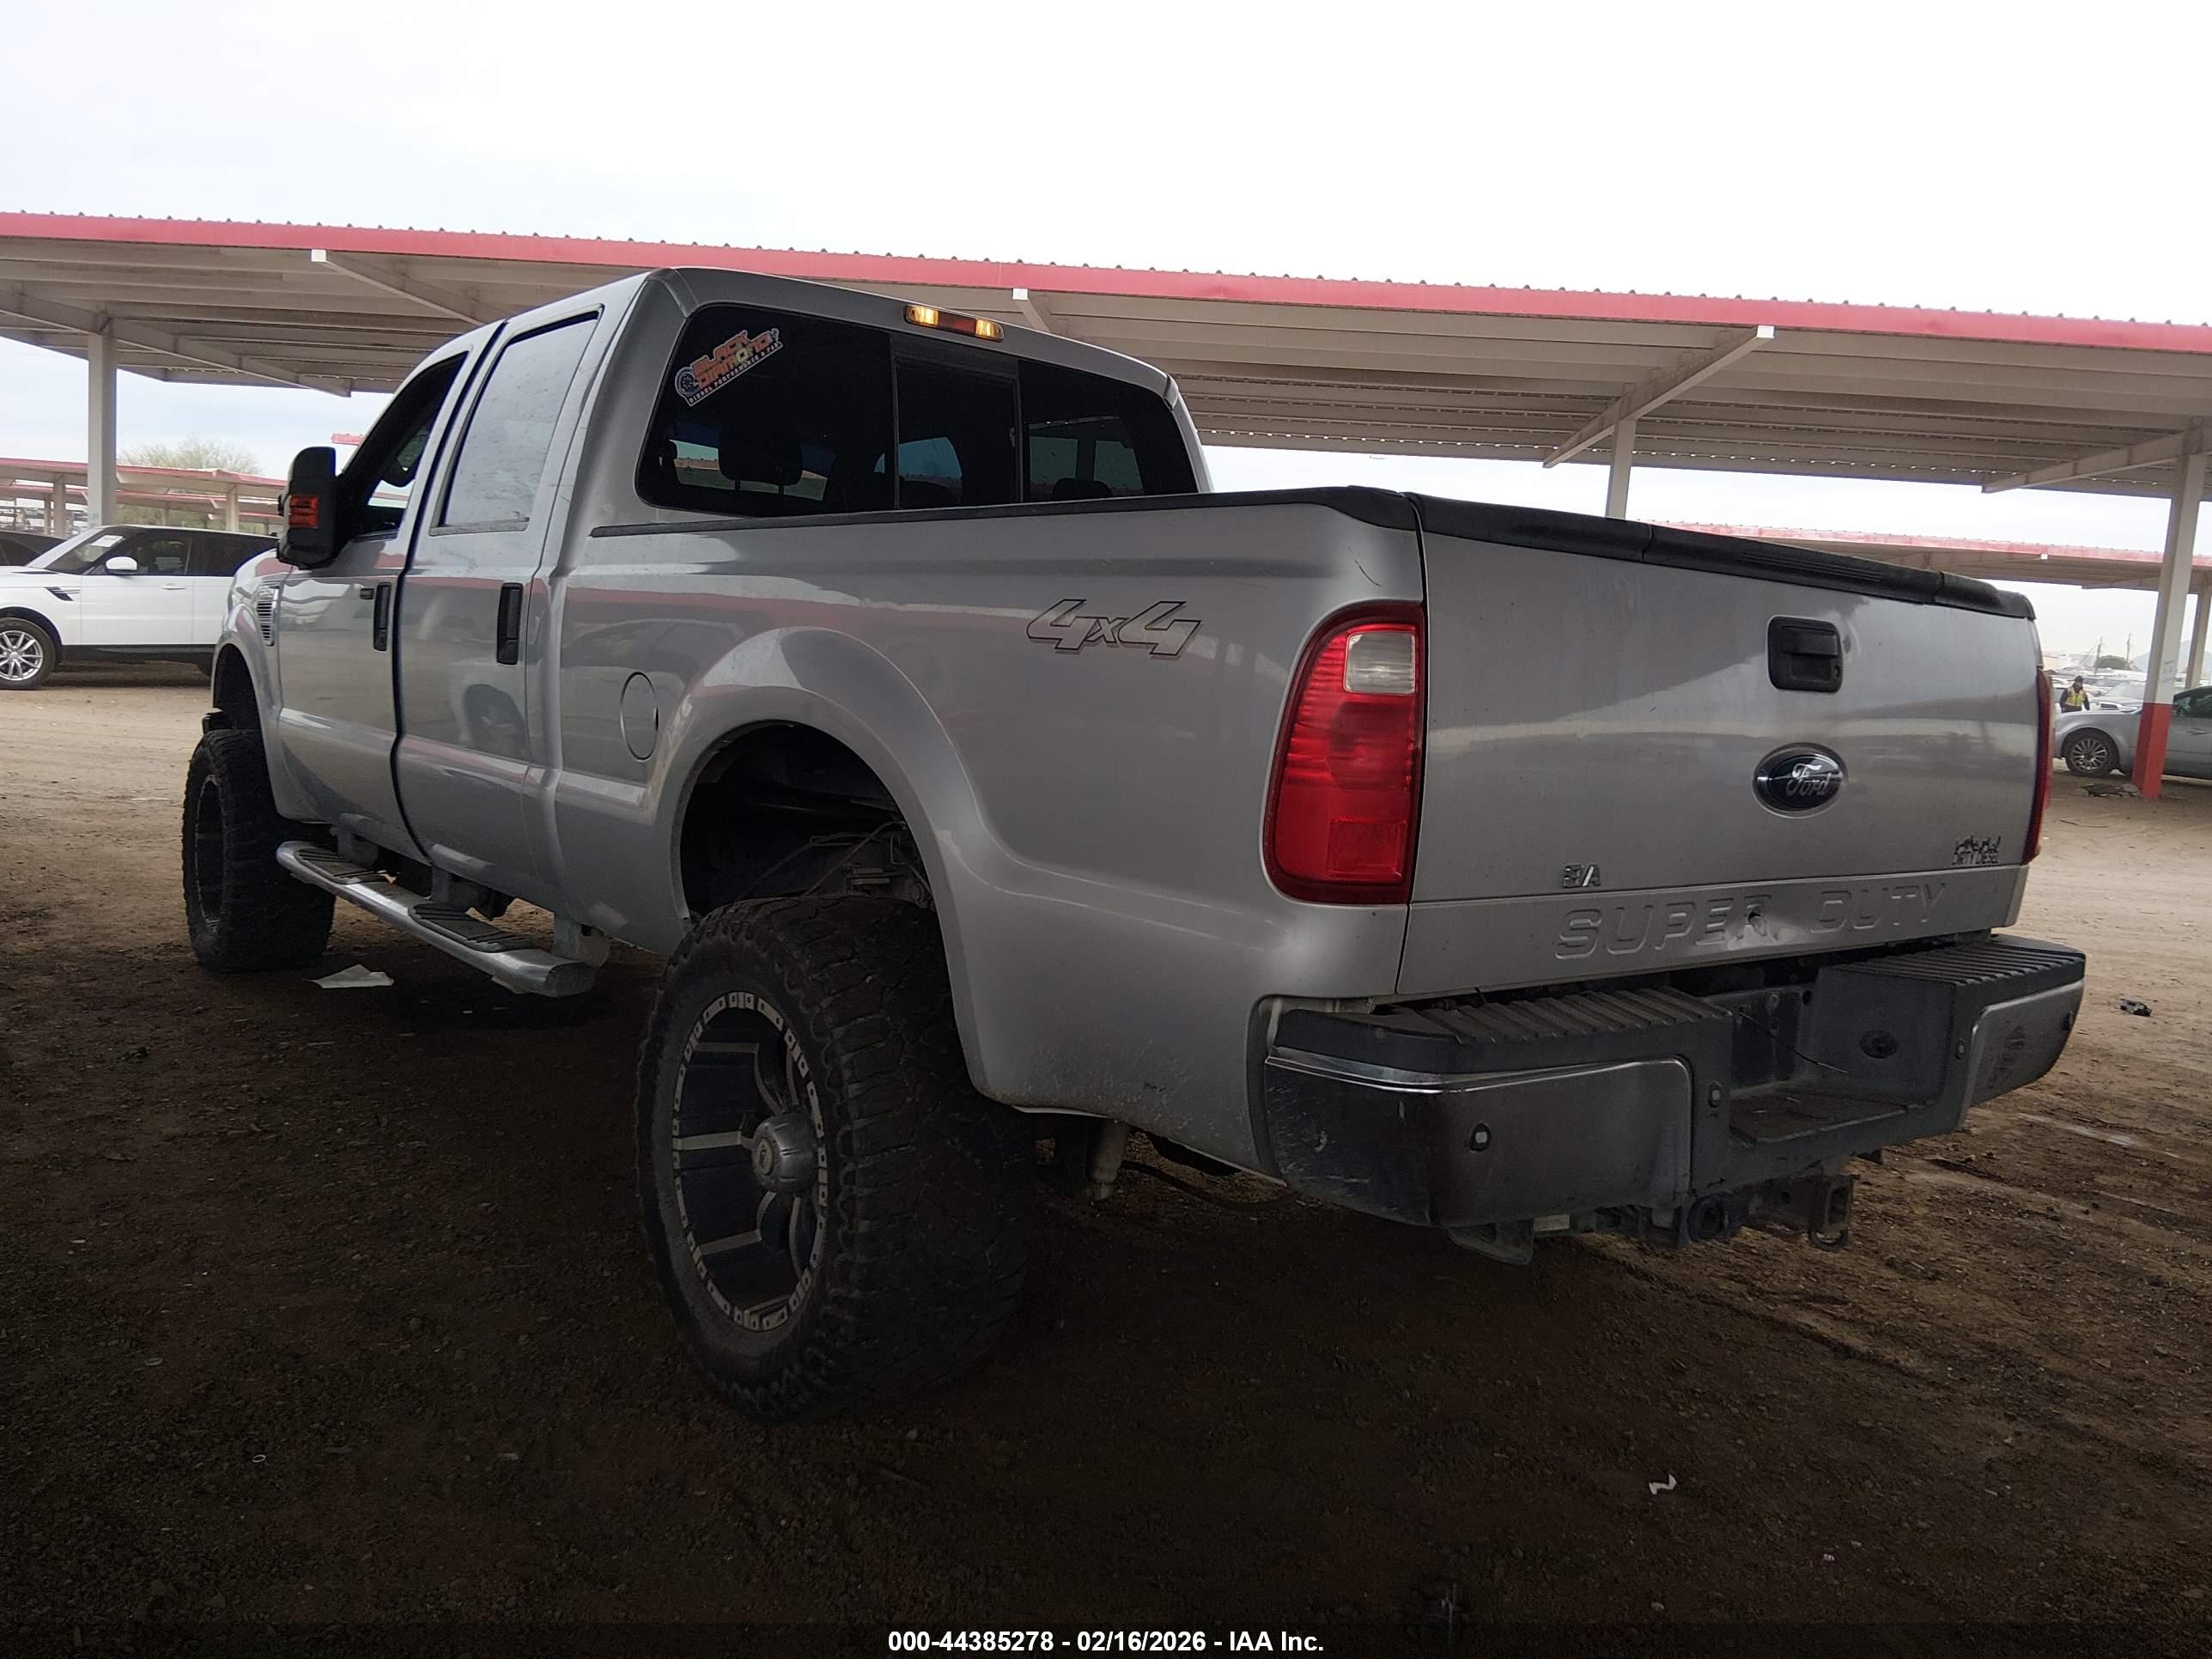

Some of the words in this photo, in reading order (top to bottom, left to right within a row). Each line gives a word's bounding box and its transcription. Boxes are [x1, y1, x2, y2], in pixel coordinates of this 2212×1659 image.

[1027, 599, 1201, 656] 4x4
[1786, 763, 1832, 796] Ford
[1555, 895, 1778, 959] SUPER
[1810, 883, 1947, 935] DUTY
